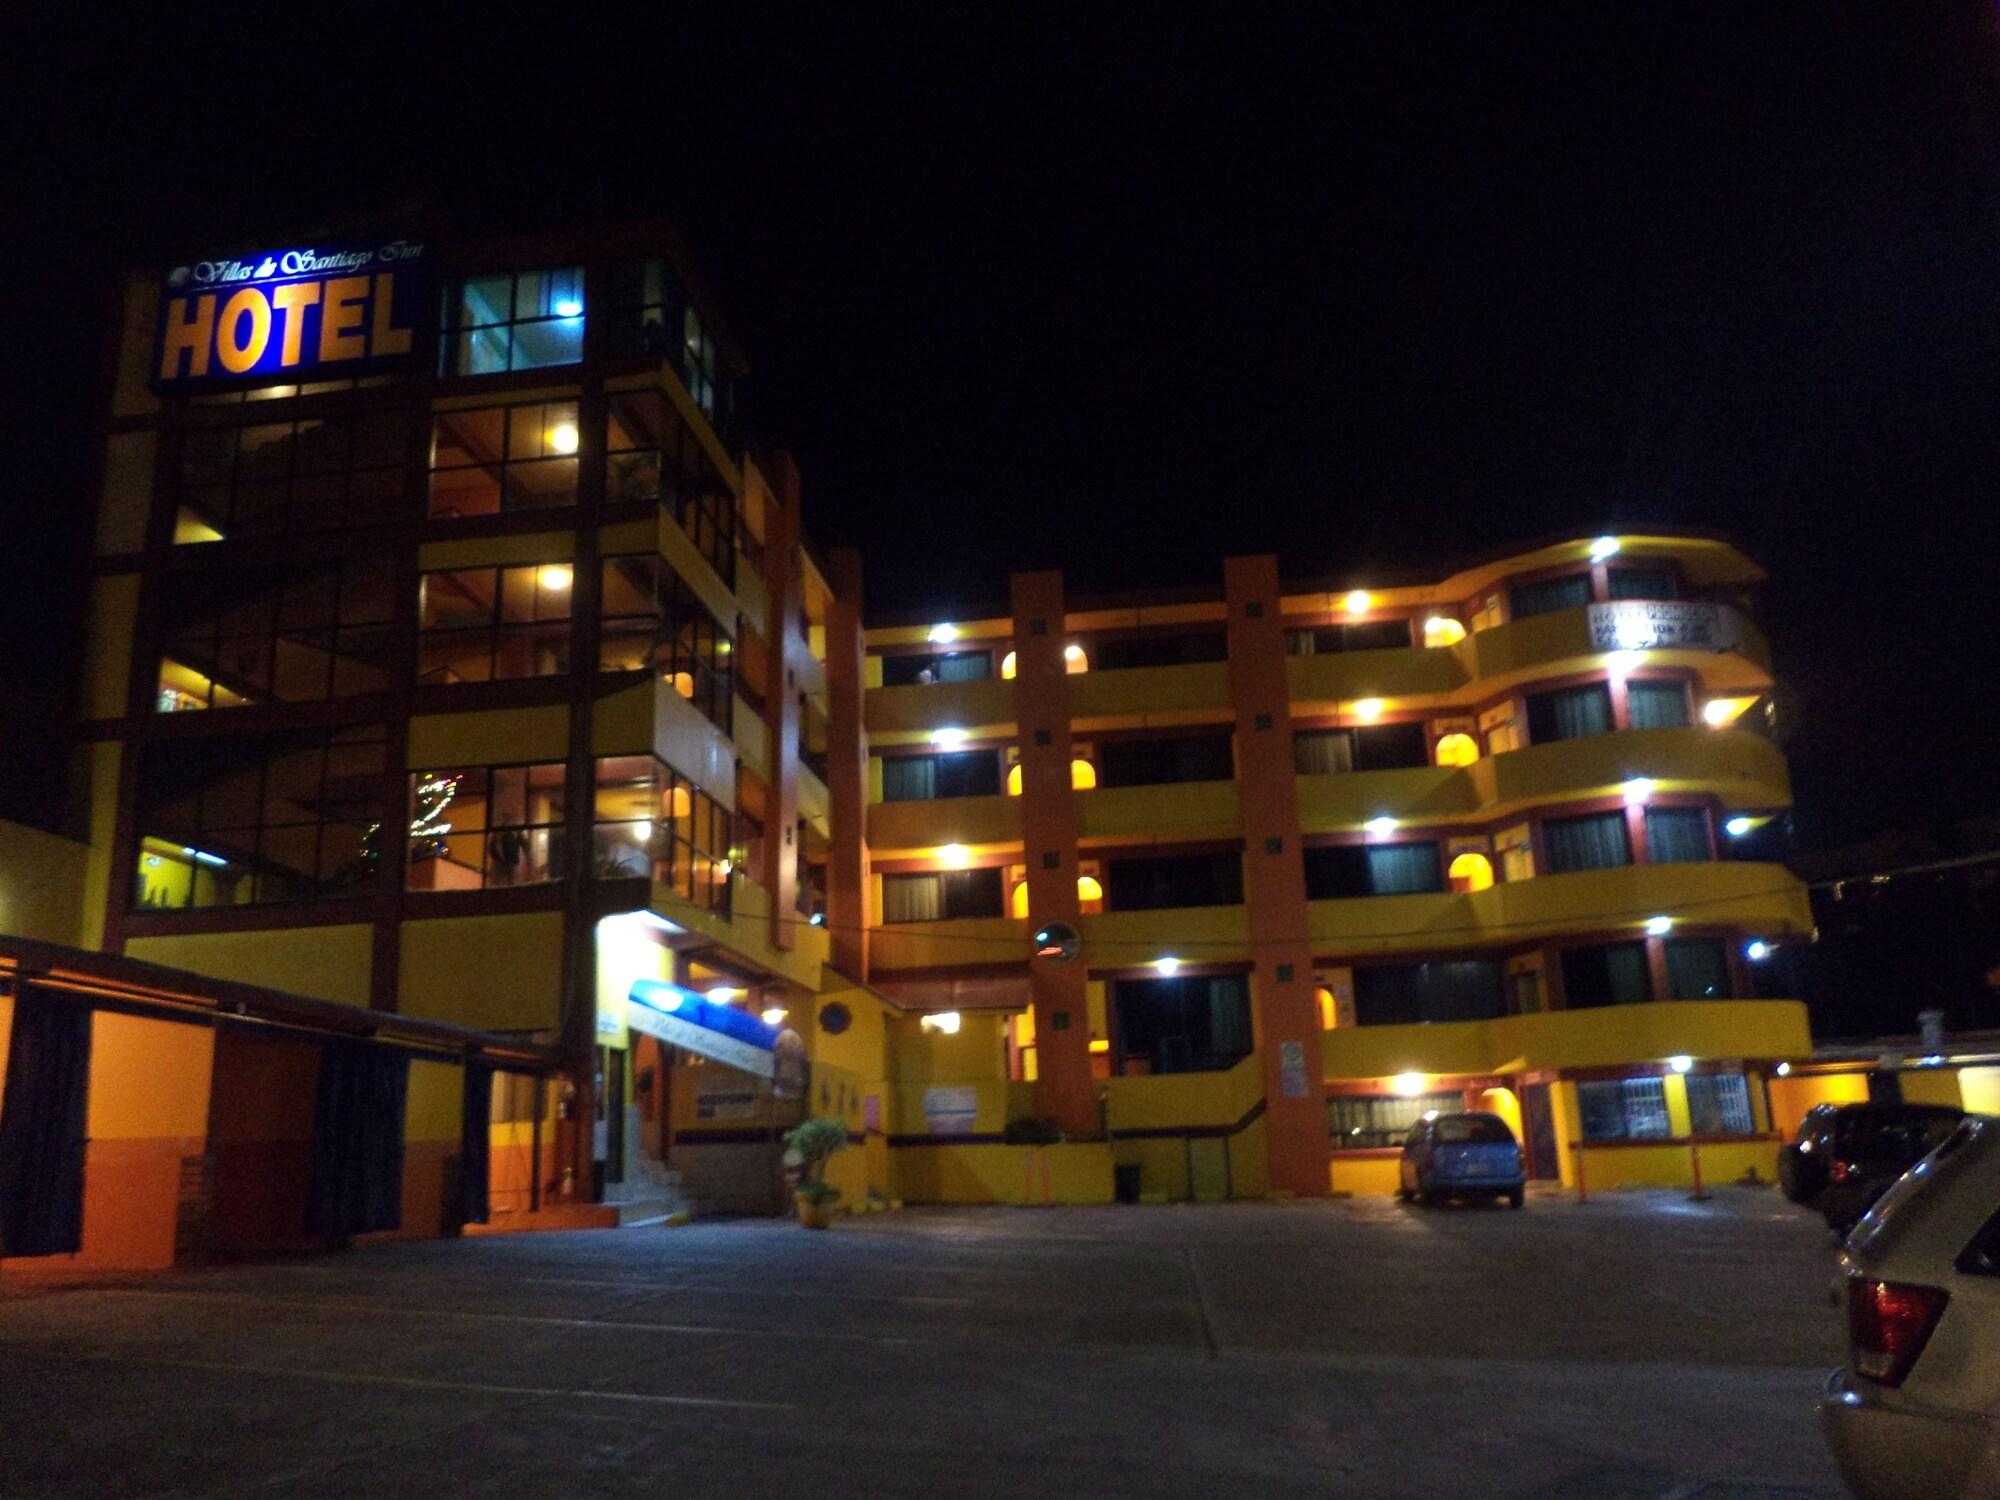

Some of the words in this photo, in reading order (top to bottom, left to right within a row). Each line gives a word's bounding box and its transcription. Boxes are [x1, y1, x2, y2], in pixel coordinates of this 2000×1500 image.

[194, 260, 254, 283] Villas
[280, 249, 373, 272] Santiago
[160, 272, 413, 379] HOTEL
